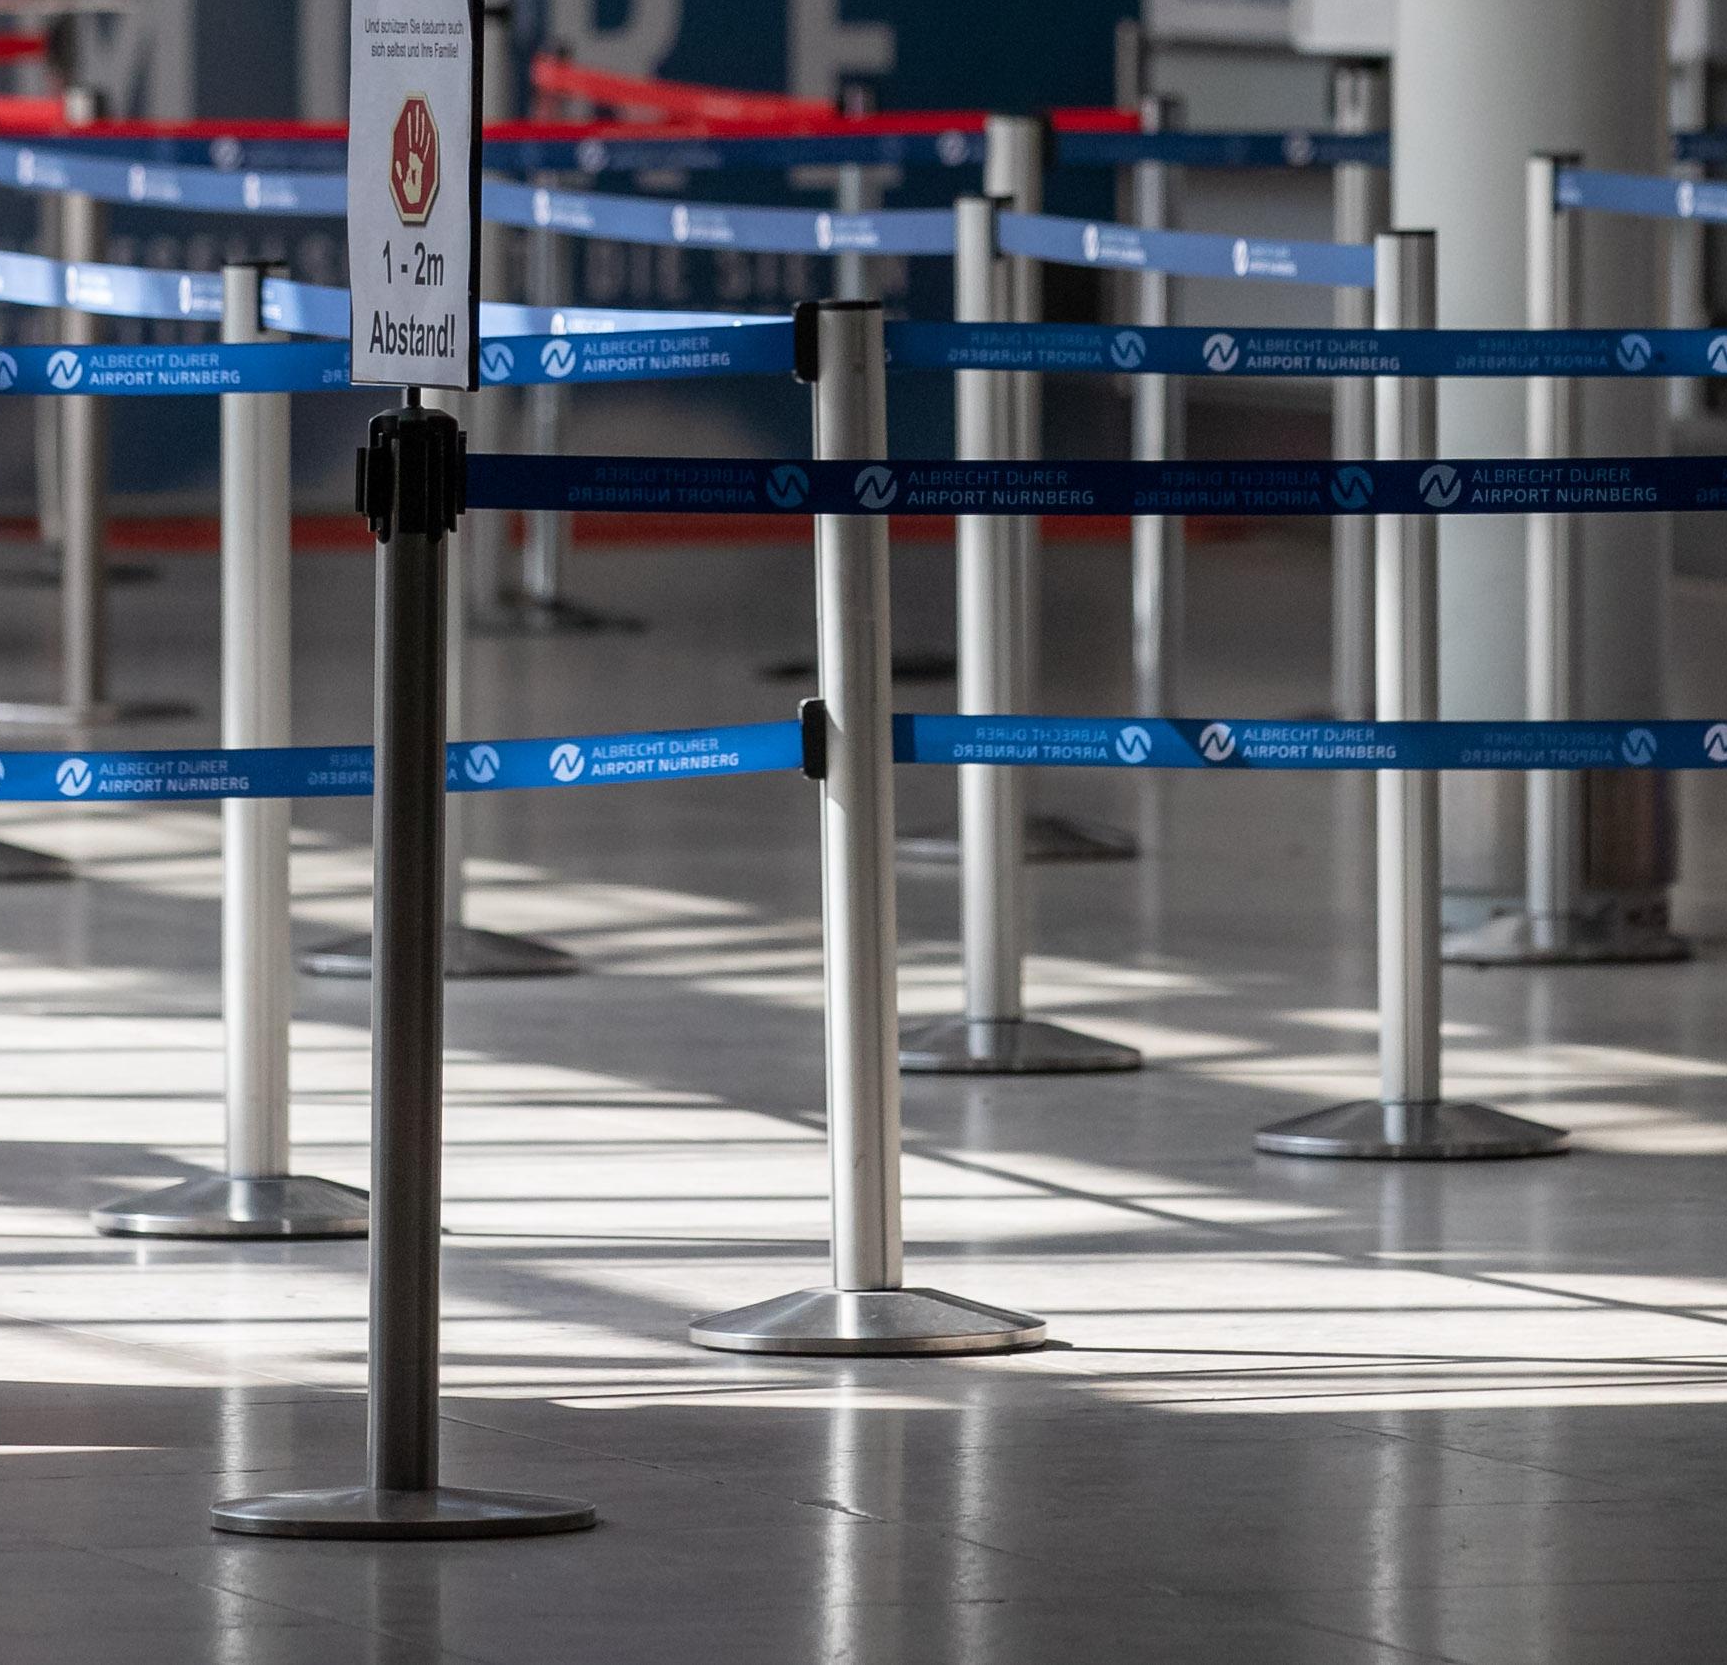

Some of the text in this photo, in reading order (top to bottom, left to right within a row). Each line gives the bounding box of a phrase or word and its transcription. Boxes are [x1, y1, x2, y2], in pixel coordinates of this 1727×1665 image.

[364, 18, 379, 33] Und
[410, 18, 421, 34] Sie
[371, 42, 385, 56] sich
[387, 42, 406, 57] selbst
[408, 42, 419, 57] und
[383, 240, 391, 284] 1
[414, 241, 444, 285] 2m
[369, 310, 456, 358] Abstand!
[583, 340, 656, 355] ALBRECHT
[1246, 338, 1322, 351] ALBRECHT
[90, 355, 164, 368] ALBRECHT
[583, 358, 645, 373] AIRPORT
[1246, 356, 1311, 369] AIRPORT
[90, 373, 153, 386] AIRPORT
[907, 470, 999, 484] ALBRECHT
[1471, 469, 1563, 483] ALBRECHT
[907, 491, 986, 505] AIRPORT
[1471, 488, 1549, 502] AIRPORT
[1243, 727, 1319, 741] ALBRECHT
[591, 741, 664, 758] ALBRECHT
[1243, 746, 1308, 760] AIRPORT
[98, 760, 173, 774] ALBRECHT
[591, 759, 653, 776] AIRPORT
[98, 778, 162, 792] AIRPORT
